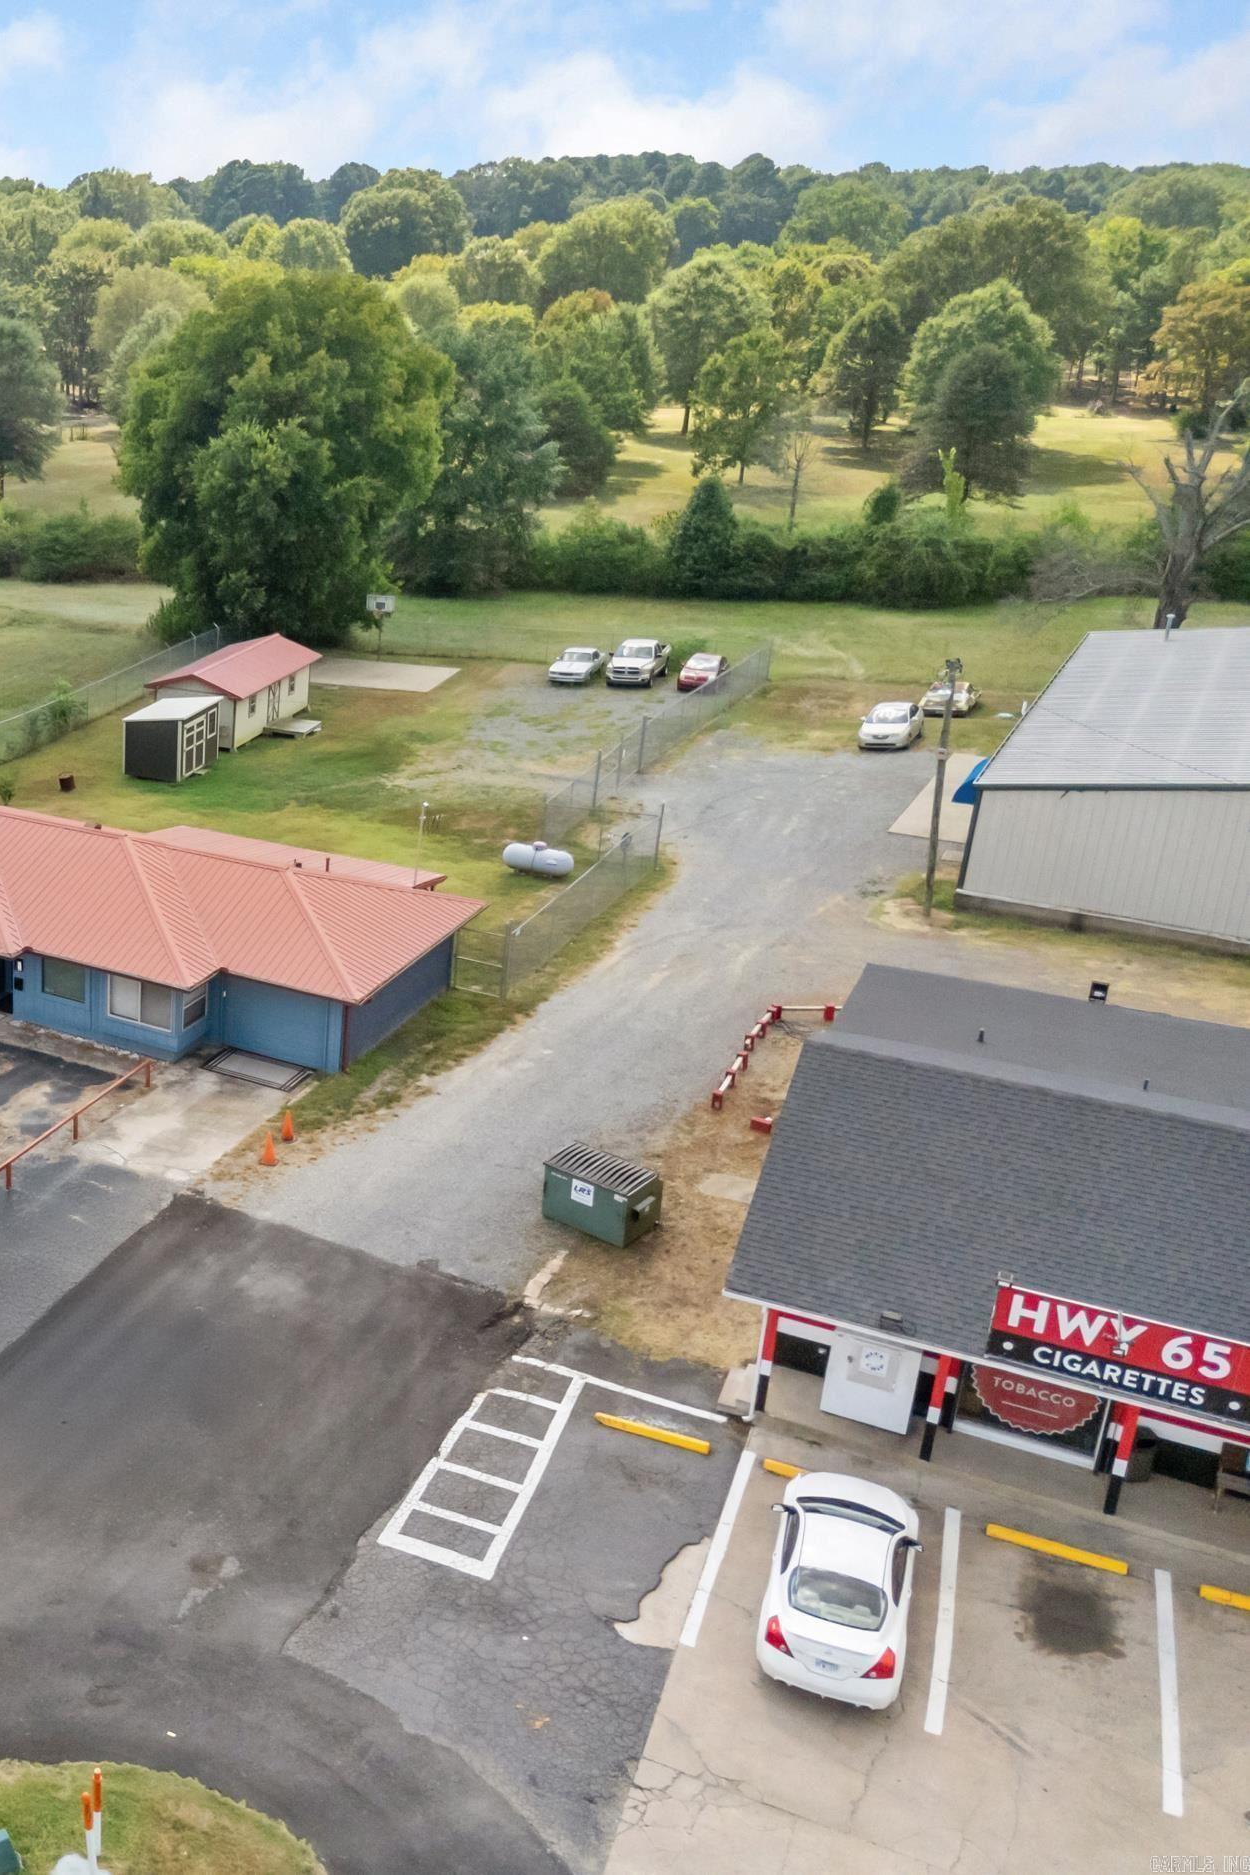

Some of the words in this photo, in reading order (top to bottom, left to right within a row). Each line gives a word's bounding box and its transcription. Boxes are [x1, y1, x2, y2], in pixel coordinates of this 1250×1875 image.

[1007, 1293, 1149, 1356] HWY
[1160, 1335, 1232, 1380] 65
[992, 1376, 1076, 1408] TOBACCO
[1033, 1346, 1207, 1406] CIGARETTES
